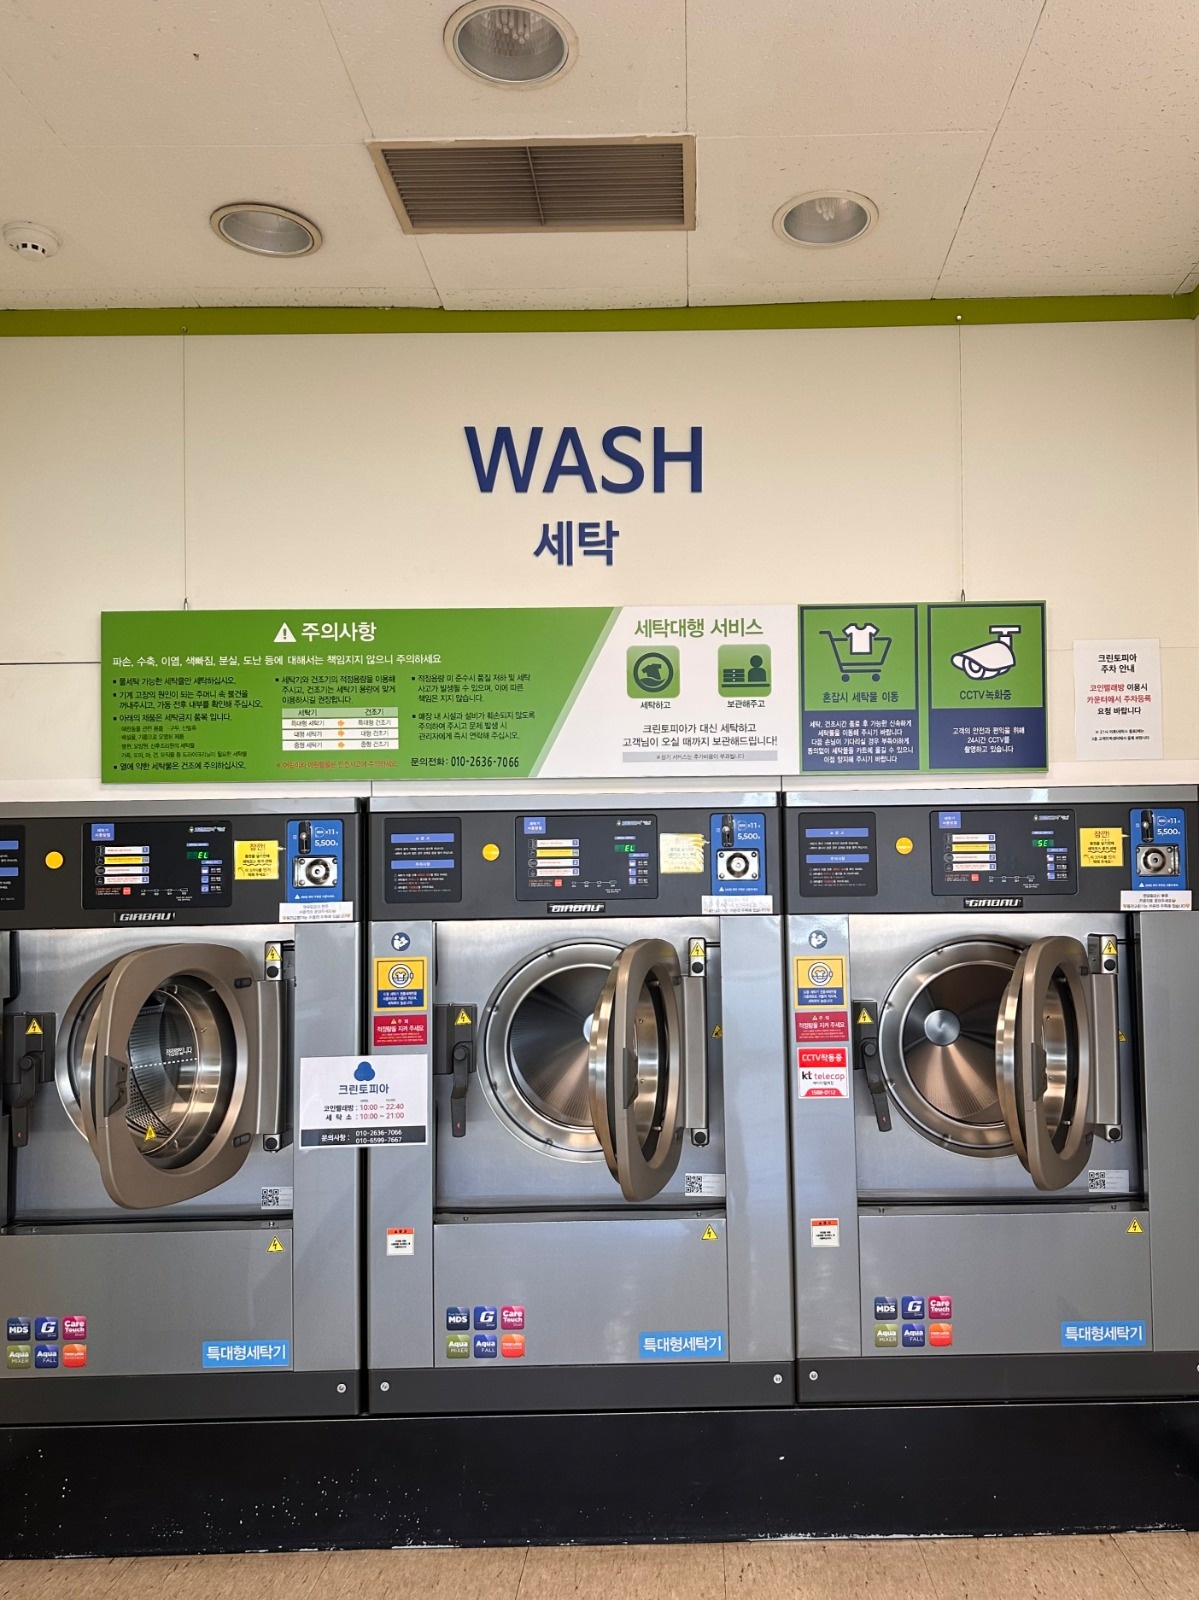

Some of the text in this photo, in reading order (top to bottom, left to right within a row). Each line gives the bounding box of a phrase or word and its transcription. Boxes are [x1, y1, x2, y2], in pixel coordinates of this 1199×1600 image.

[464, 426, 702, 493] WASH
[534, 520, 619, 566] 세탁
[301, 622, 377, 642] 주의사항
[635, 618, 763, 638] 세탁대행 서비스
[112, 654, 442, 667] 파손, 수축, 이염, 색빠짐, 분실, 도난 등에 대해서는 책임지지 않으니 주의하세요
[1098, 654, 1137, 663] 크린토피아
[1101, 664, 1135, 673] 주차 안내
[282, 676, 308, 684] 세탁기와
[376, 675, 395, 683] 이용해
[282, 686, 304, 694] 주시고,
[307, 686, 334, 694] 건조기는
[360, 685, 379, 693] 용량에
[382, 685, 396, 693] 맞게
[1090, 683, 1147, 692] 코인빨래방 이용시
[120, 691, 133, 699] 기계
[135, 691, 155, 699] 고장의
[158, 691, 178, 699] 원인이
[181, 690, 194, 698] 되는
[196, 690, 216, 698] 주머니
[823, 691, 899, 702] 혼잡시 세탁물 이동
[960, 690, 1011, 700] CCTV녹화중
[282, 696, 315, 704] 이용하시길
[727, 700, 765, 708] 보관해주고
[1087, 696, 1122, 704] 카운터에서
[640, 701, 671, 710] 세탁하고
[365, 708, 384, 716] 건조기
[1098, 706, 1141, 715] 요청 바랍니다
[443, 712, 462, 720] 시설과
[465, 712, 485, 720] 설비가
[447, 722, 466, 730] 주시고
[643, 723, 757, 734] 크린토피아가 대신 세탁하고
[454, 732, 467, 740] 즉시
[469, 732, 489, 740] 연락해
[623, 736, 778, 747] 고객님이 오실 때까지 보관해드립니다!
[120, 762, 133, 770] 열에
[136, 762, 149, 770] 약한
[152, 762, 178, 770] 세탁물은
[204, 761, 246, 769] 주의하십시오.
[411, 756, 519, 767] 문의전화: 010-2636-7066
[802, 1054, 842, 1062] CCTV작동중
[802, 1071, 812, 1079] kt
[339, 1084, 389, 1095] 크린토피아
[1065, 1325, 1142, 1341] 특대형세탁기
[643, 1336, 721, 1352] 특대형세탁기
[207, 1344, 286, 1361] 특대형세탁기
